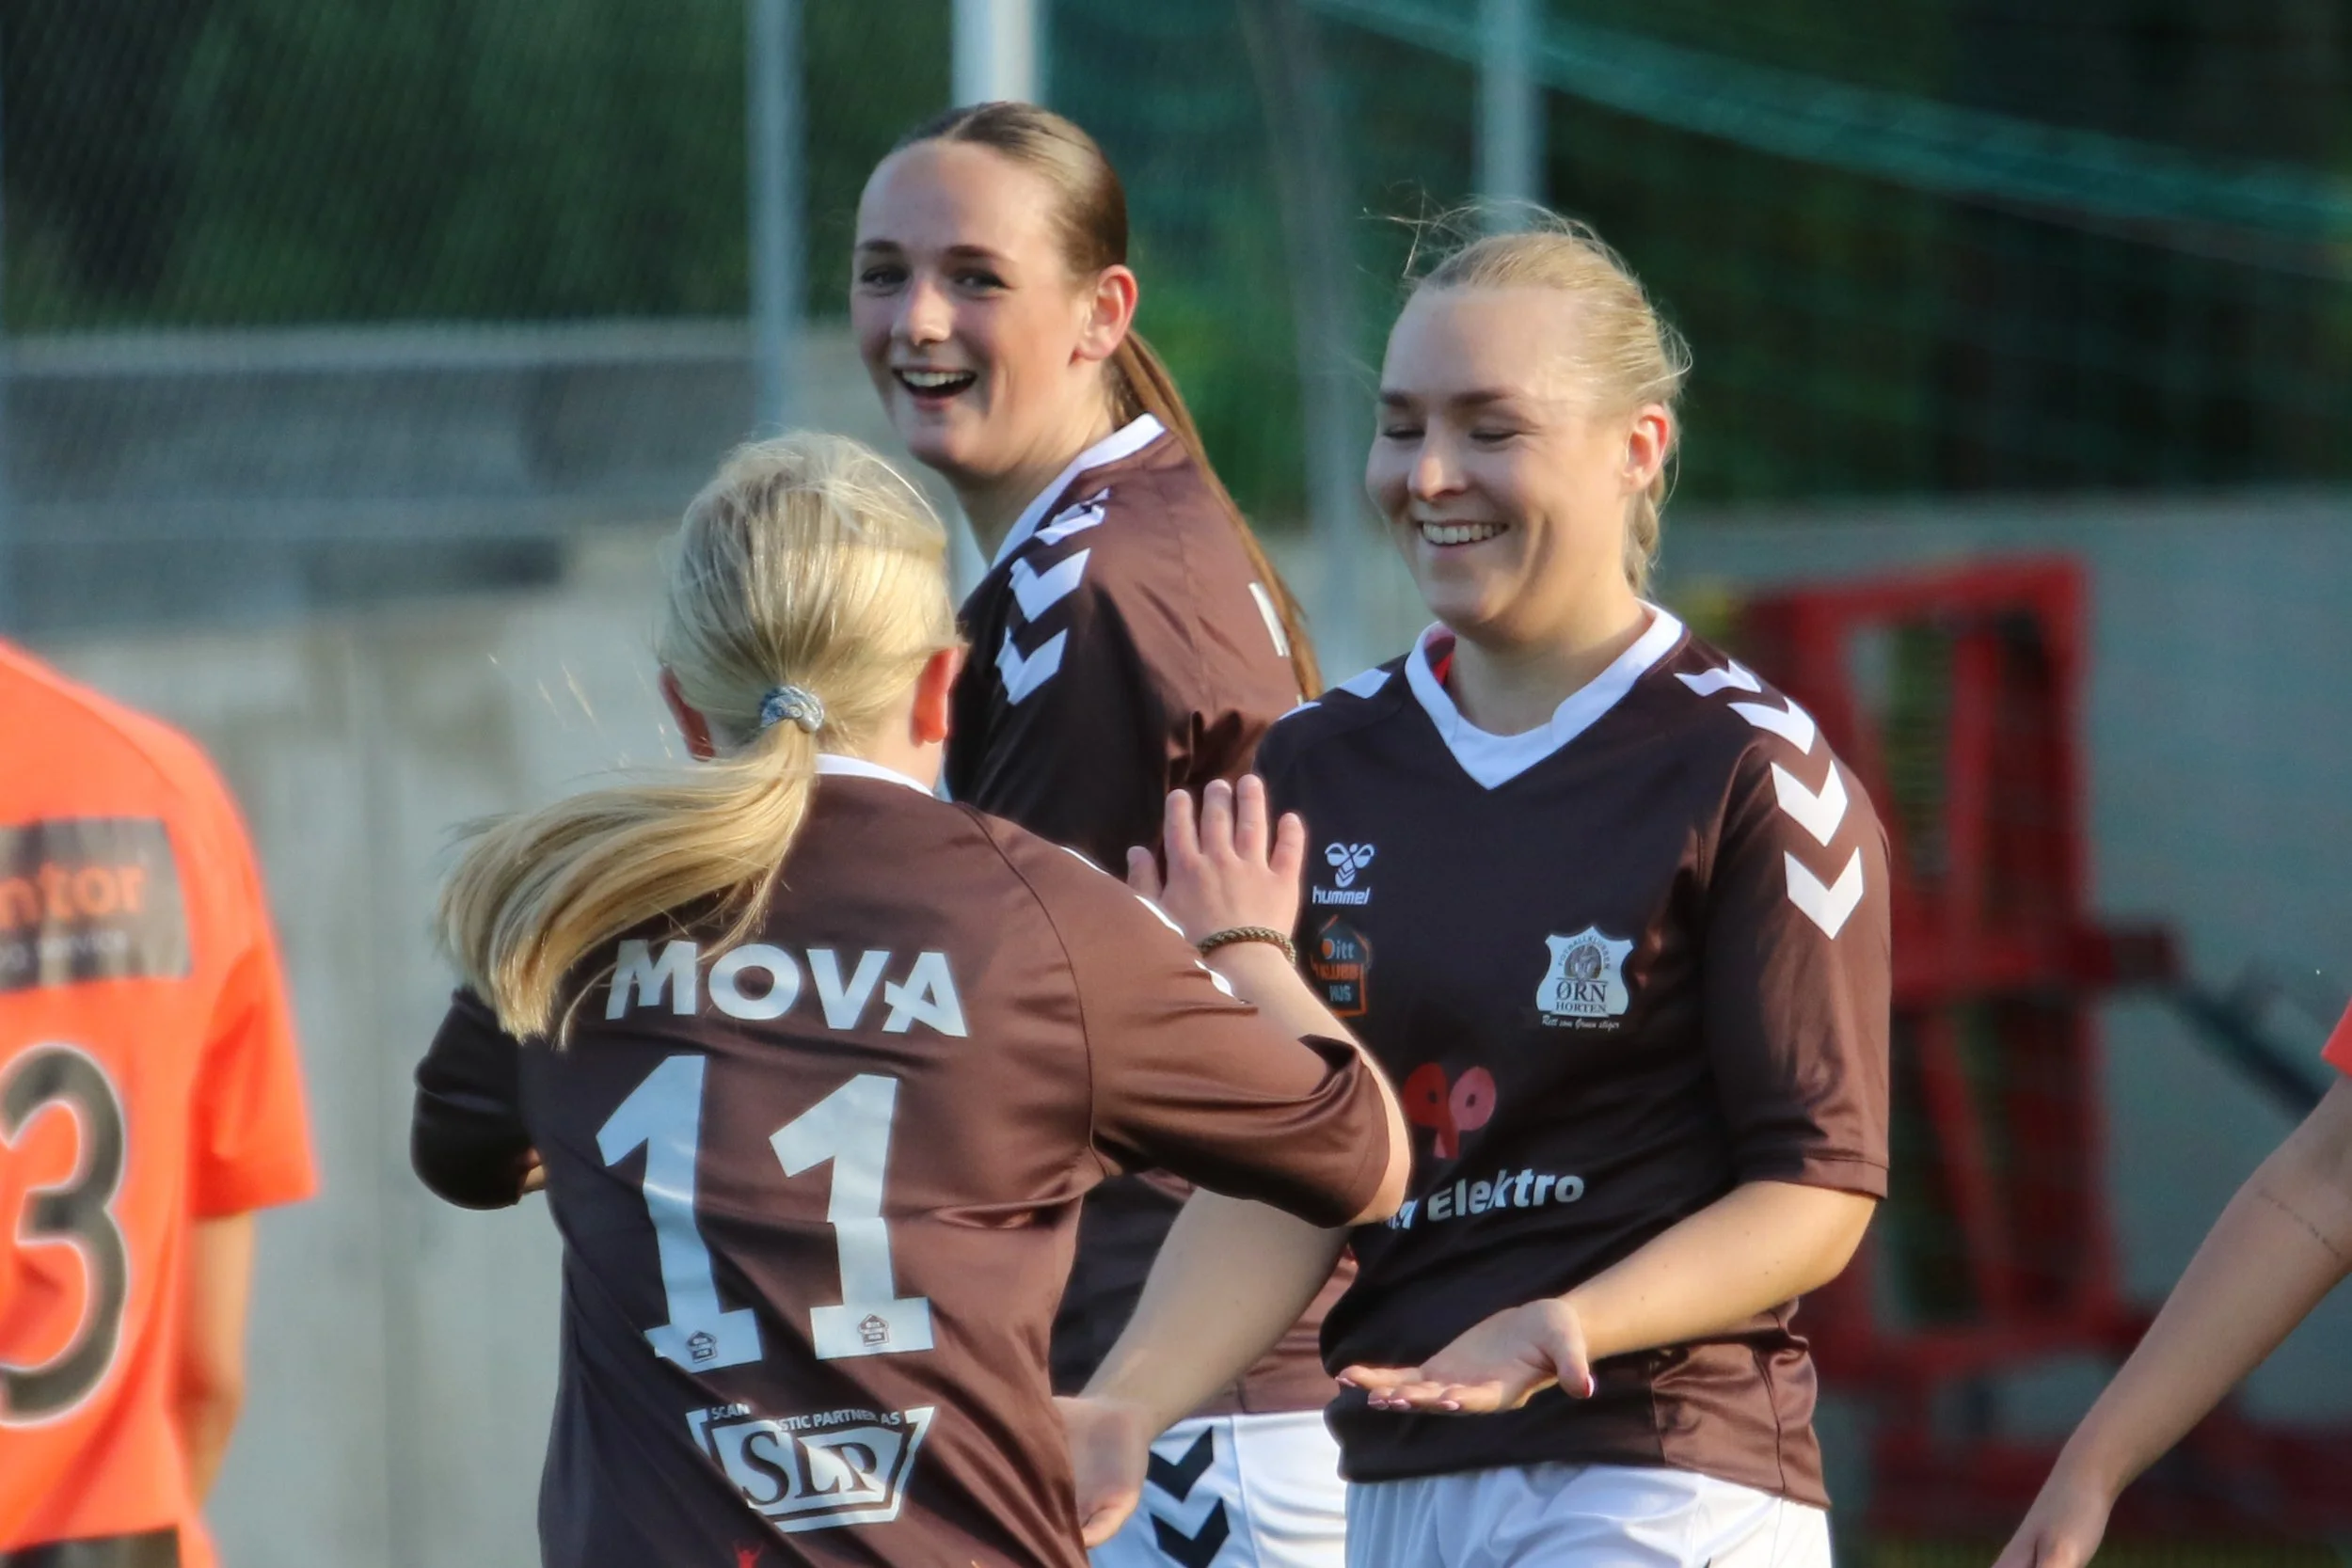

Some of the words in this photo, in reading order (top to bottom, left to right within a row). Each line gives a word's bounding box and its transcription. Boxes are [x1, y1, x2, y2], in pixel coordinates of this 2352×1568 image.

[1312, 886, 1371, 905] hummel
[1322, 938, 1356, 960] Ditt
[605, 940, 968, 1038] MOVA
[1555, 981, 1608, 1003] ØRN
[1555, 1002, 1608, 1014] HORTEN
[1427, 1168, 1585, 1221] Elektro
[595, 1053, 935, 1374] 11
[711, 1403, 750, 1420] SCAN
[880, 1411, 900, 1426] AS
